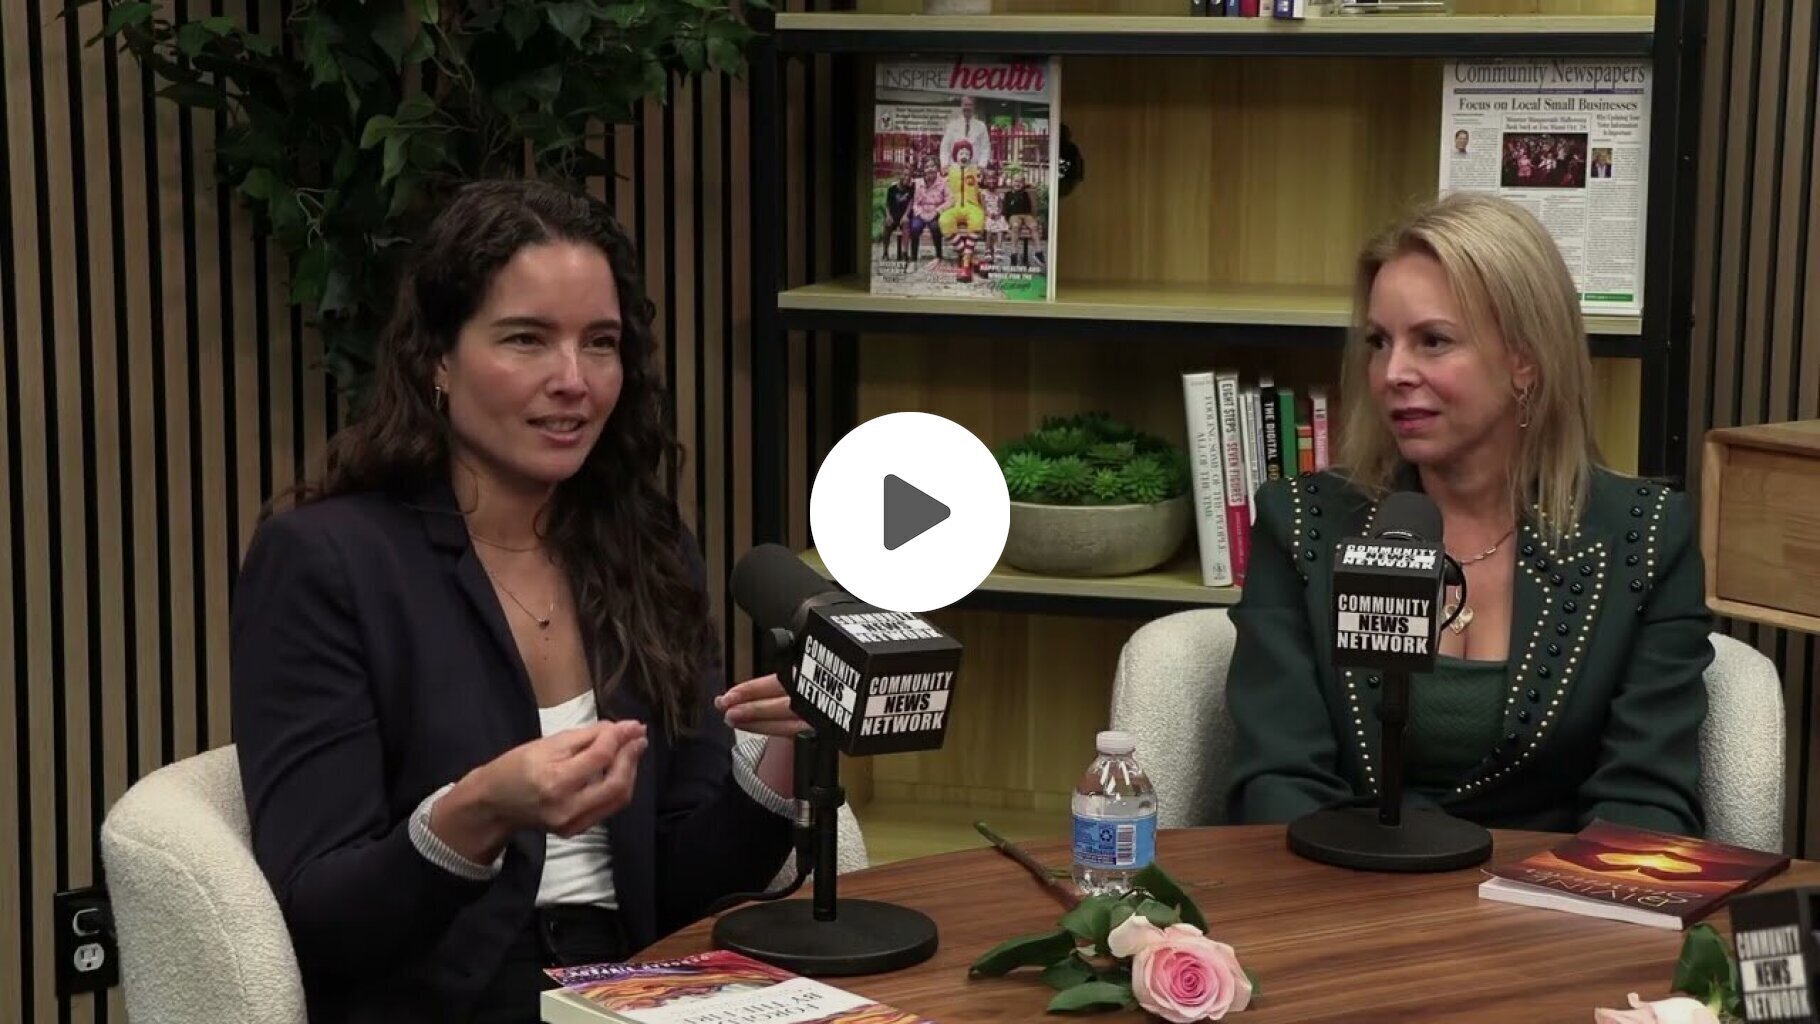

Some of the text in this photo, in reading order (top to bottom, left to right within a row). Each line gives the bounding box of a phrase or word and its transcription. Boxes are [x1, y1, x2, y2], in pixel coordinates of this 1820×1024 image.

[882, 55, 1045, 92] INSPIRE health
[1455, 58, 1645, 92] Community Newspapers
[1459, 97, 1638, 111] Focus on Local Small Businesses
[1222, 383, 1235, 406] EIGHT
[1204, 396, 1216, 440] FOOLING
[1223, 408, 1237, 433] STEPS
[1263, 402, 1275, 421] THE
[1265, 423, 1278, 460] DIGITAL
[1209, 443, 1219, 469] SOME
[1226, 442, 1239, 467] SEVEN
[1197, 432, 1213, 517] ALL OF THE TIME
[1212, 474, 1221, 485] OF
[1229, 468, 1243, 503] FIGURES
[1213, 492, 1223, 508] THE
[1342, 556, 1434, 570] NETWORK
[1346, 544, 1437, 557] COMMUNITY
[1338, 594, 1430, 616] COMMUNITY
[1358, 614, 1410, 634] NEWS
[1337, 632, 1428, 654] NETWORK
[805, 634, 861, 690] COMMUNITY
[813, 663, 845, 702] NEWS
[869, 671, 954, 695] COMMUNITY
[796, 675, 853, 733] NETWORK
[883, 693, 931, 714] NEWS
[860, 711, 945, 736] NETWORK
[1736, 925, 1801, 960] COMMUNITY
[1755, 958, 1791, 987] NEWS
[1744, 988, 1811, 1020] NETWORK
